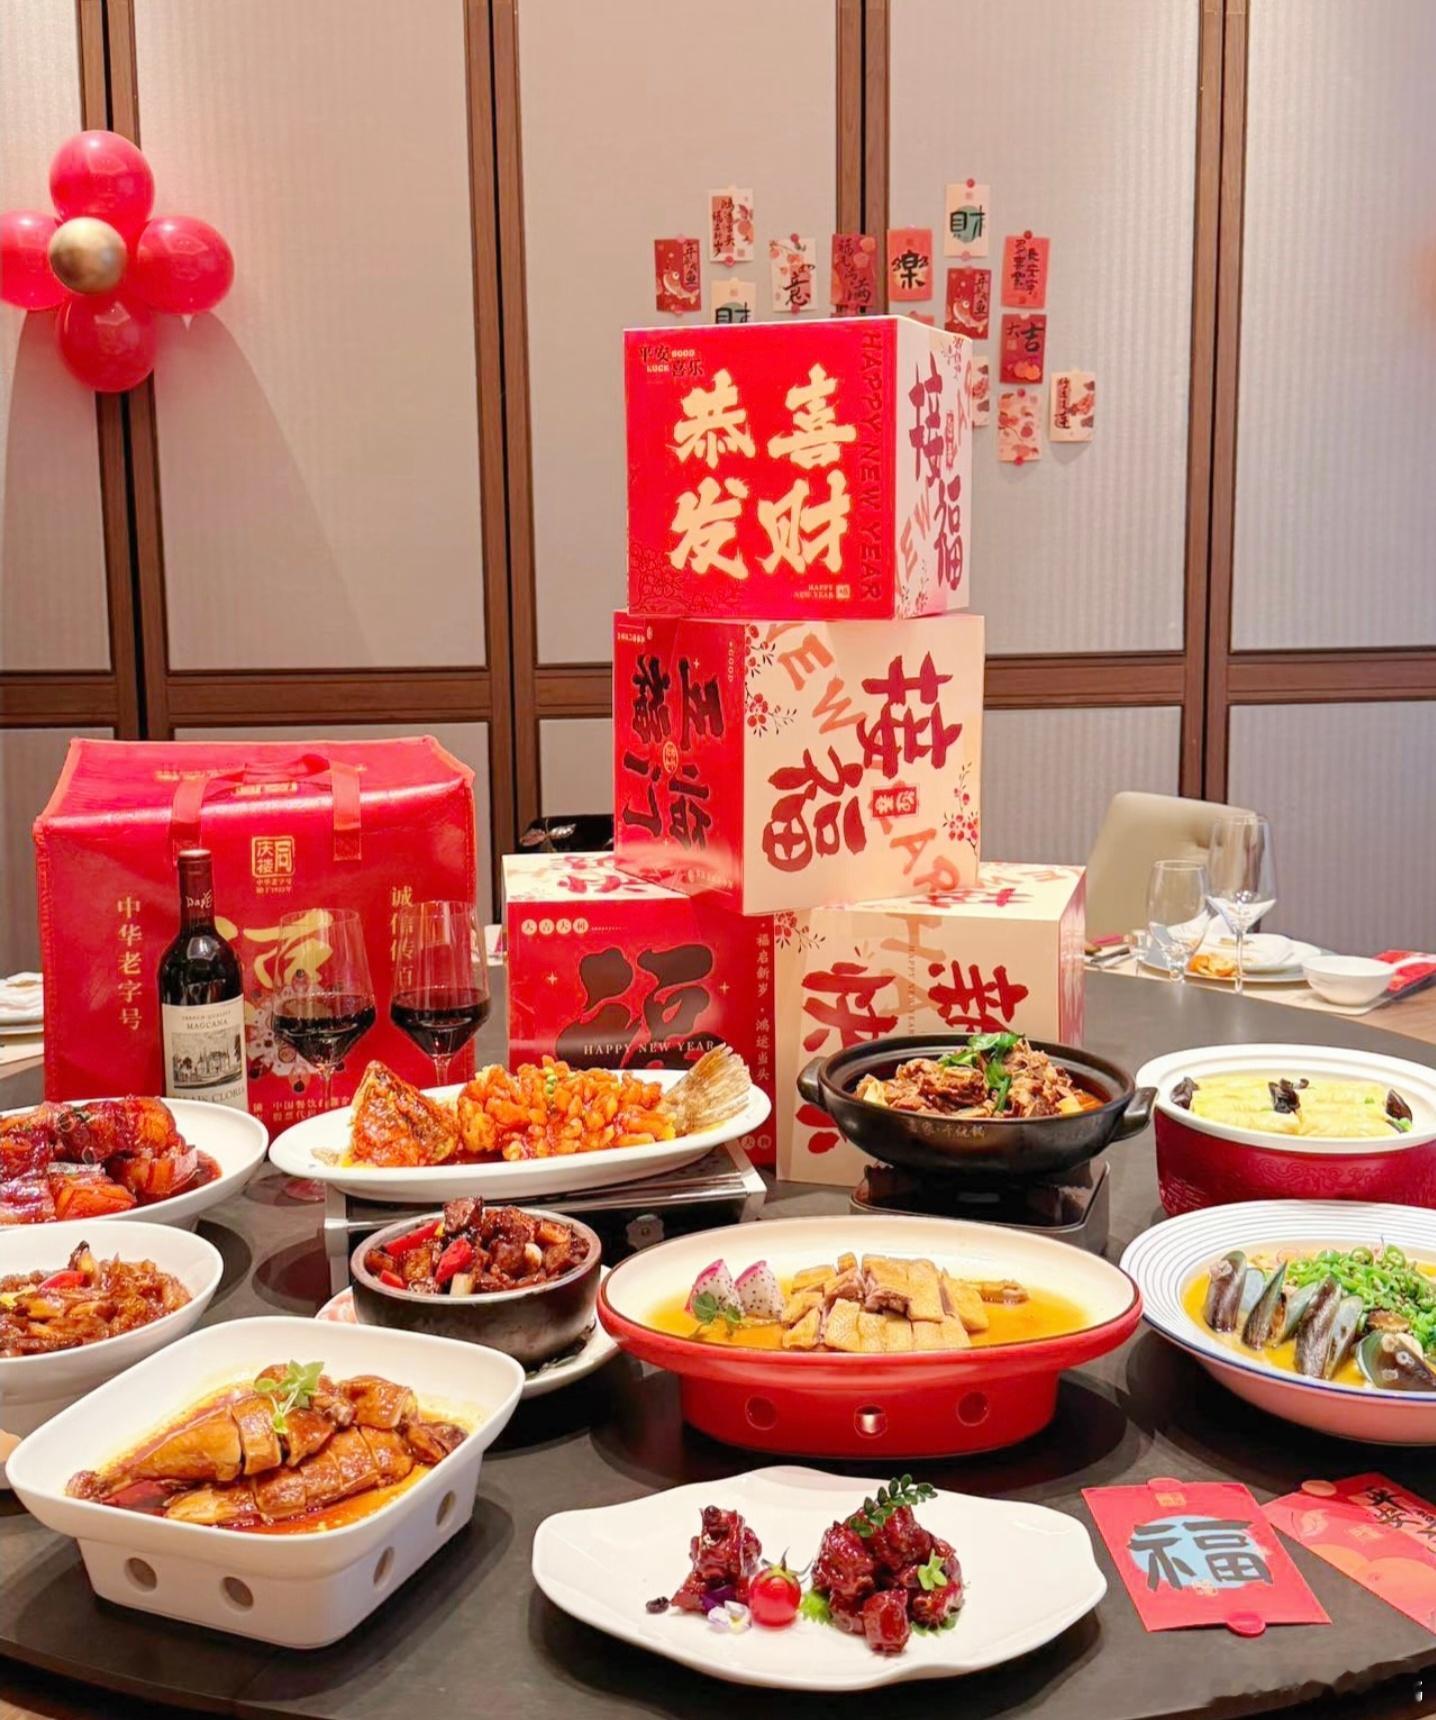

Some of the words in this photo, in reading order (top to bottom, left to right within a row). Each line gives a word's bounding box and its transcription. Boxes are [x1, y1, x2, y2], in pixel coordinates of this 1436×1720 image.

[666, 362, 856, 469] 恭喜
[860, 331, 882, 432] HAPPY
[860, 444, 881, 510] NEW
[667, 470, 851, 580] 发财
[860, 523, 882, 600] YEAR
[118, 897, 142, 1030] 中华老字号
[584, 1045, 630, 1055] HAPPY
[639, 1041, 670, 1053] NEW
[678, 1040, 714, 1051] YEAR
[1127, 1520, 1273, 1592] 福
